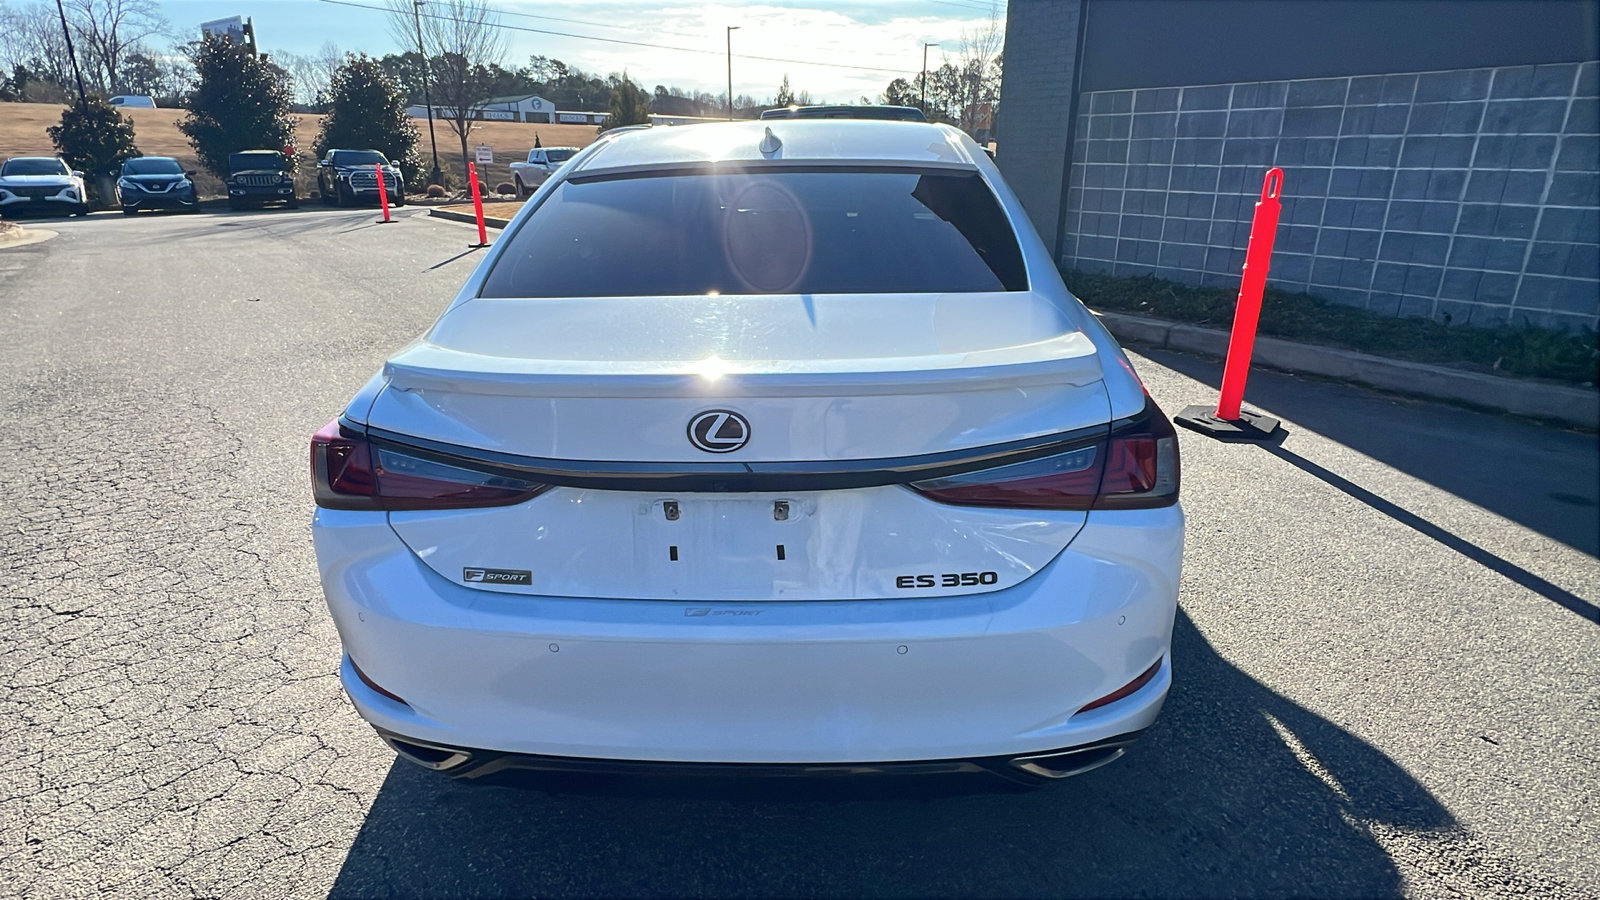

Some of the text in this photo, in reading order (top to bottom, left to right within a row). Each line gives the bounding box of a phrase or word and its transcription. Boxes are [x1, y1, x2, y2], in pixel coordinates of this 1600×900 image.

[464, 568, 527, 582] F SPORT
[896, 571, 998, 589] ES 350
[712, 609, 766, 617] SPORT
